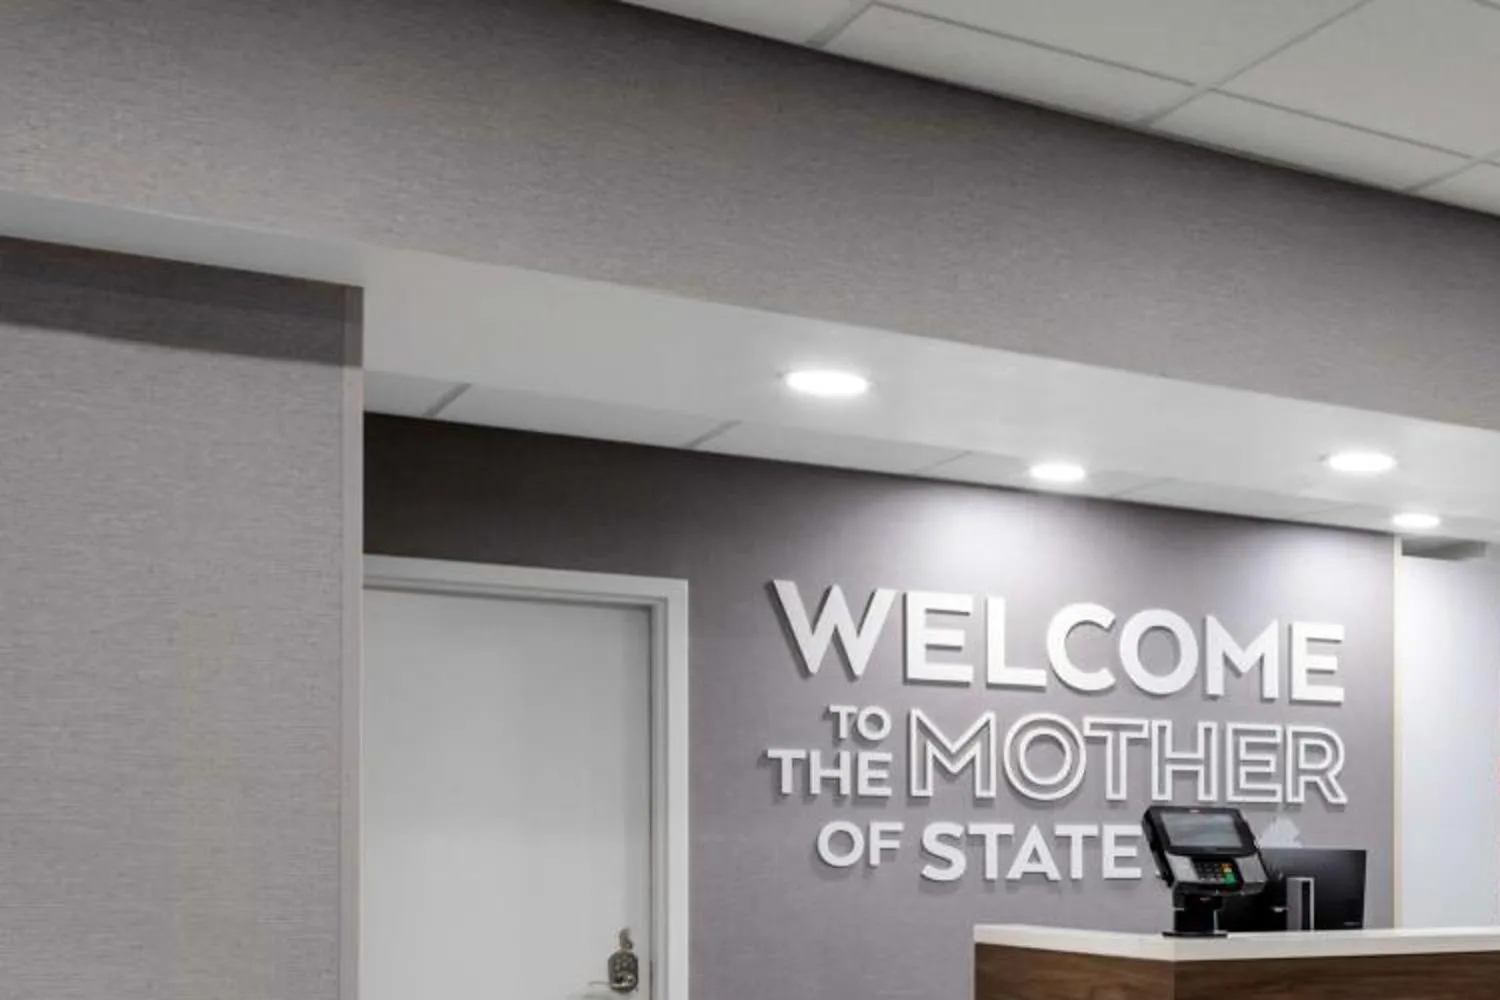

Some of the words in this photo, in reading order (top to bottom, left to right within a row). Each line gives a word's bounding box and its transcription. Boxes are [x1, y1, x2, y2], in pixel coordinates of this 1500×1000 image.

[772, 579, 1345, 703] WELCOME
[767, 748, 893, 797] THE
[910, 708, 1348, 804] MOTHER
[829, 704, 892, 741] TO
[817, 821, 904, 868] OF
[921, 822, 1161, 882] STATE
